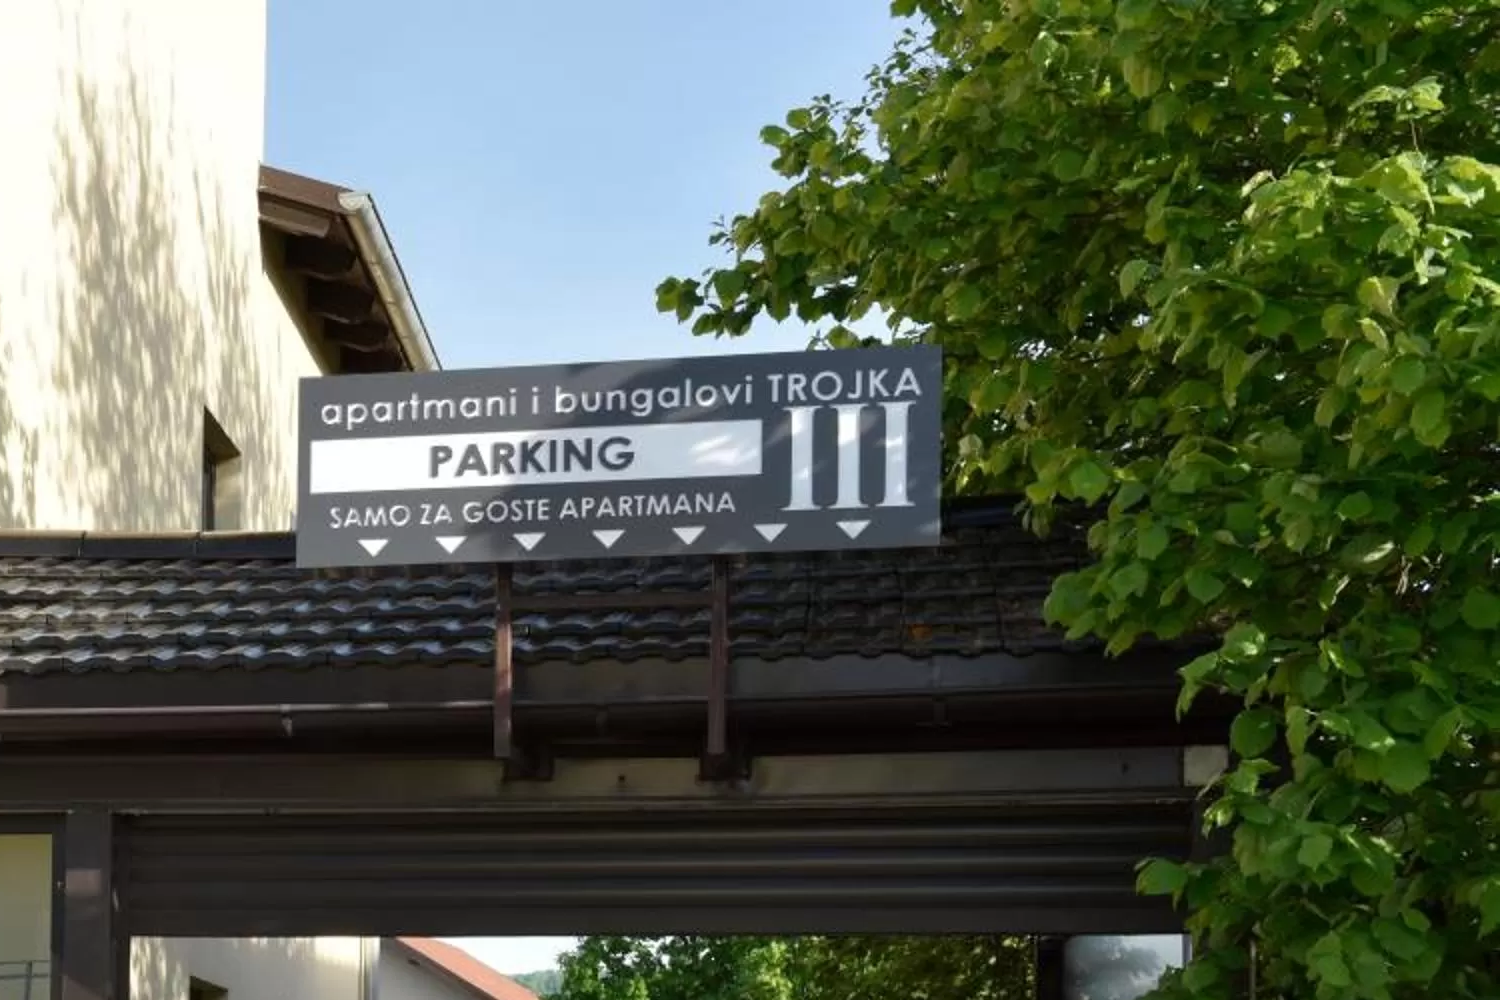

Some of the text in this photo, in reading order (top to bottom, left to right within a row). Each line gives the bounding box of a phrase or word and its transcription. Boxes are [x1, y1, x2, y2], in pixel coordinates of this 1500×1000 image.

[321, 367, 922, 431] apartmani i bungalovi TROJKA
[429, 436, 635, 478] PARKING
[329, 491, 736, 529] SAMO ZA GOSTE APARTMANA
